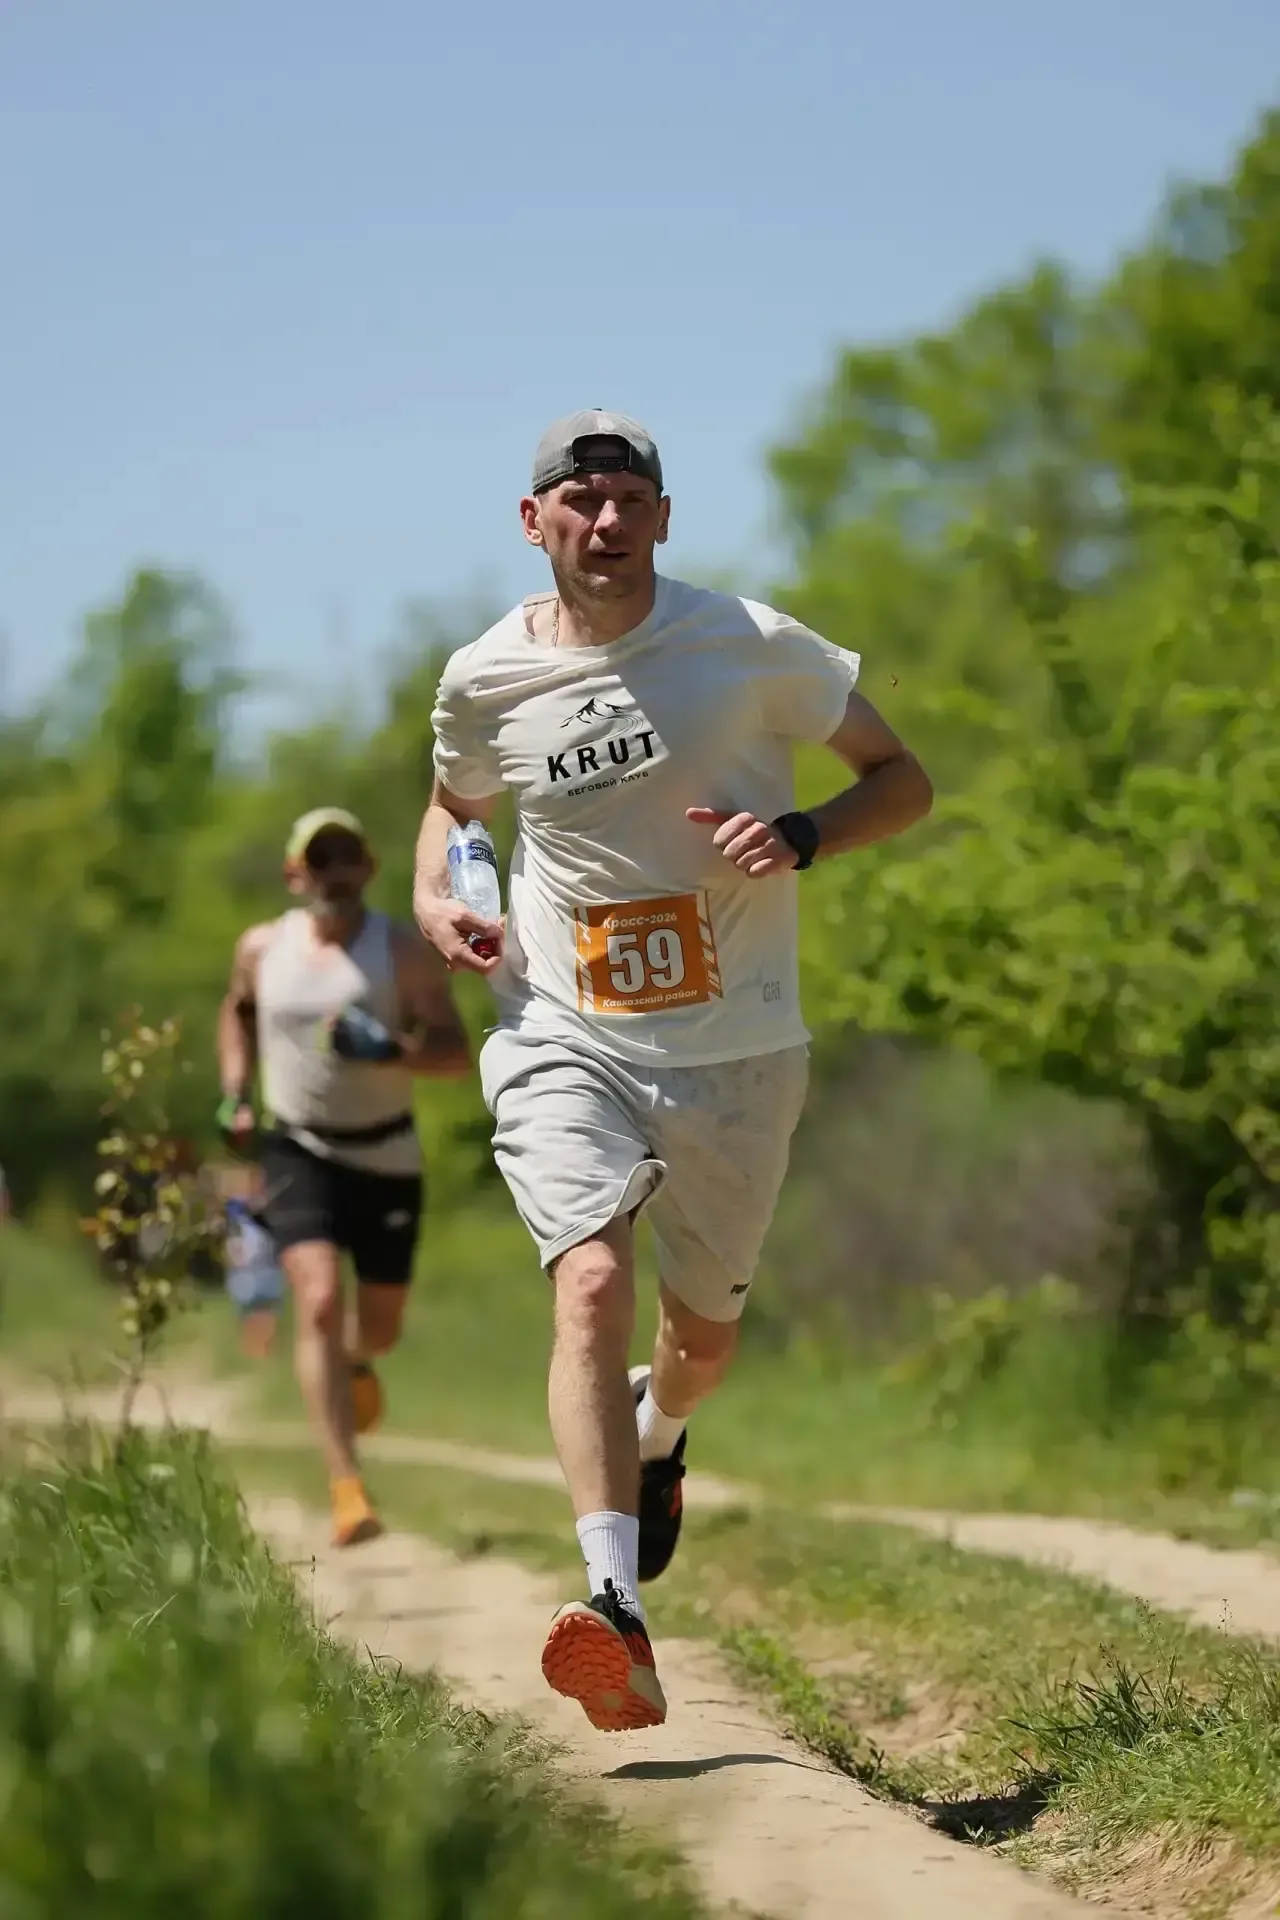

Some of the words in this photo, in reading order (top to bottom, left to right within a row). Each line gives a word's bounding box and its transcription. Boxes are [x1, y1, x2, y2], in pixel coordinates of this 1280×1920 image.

[547, 731, 654, 782] KRUT
[568, 777, 617, 797] БЕГОВОЙ
[620, 771, 649, 784] КЛУБ
[603, 912, 678, 931] Кросс-2026
[606, 927, 685, 994] 59
[603, 993, 664, 1008] Кавказский
[665, 989, 698, 1003] район
